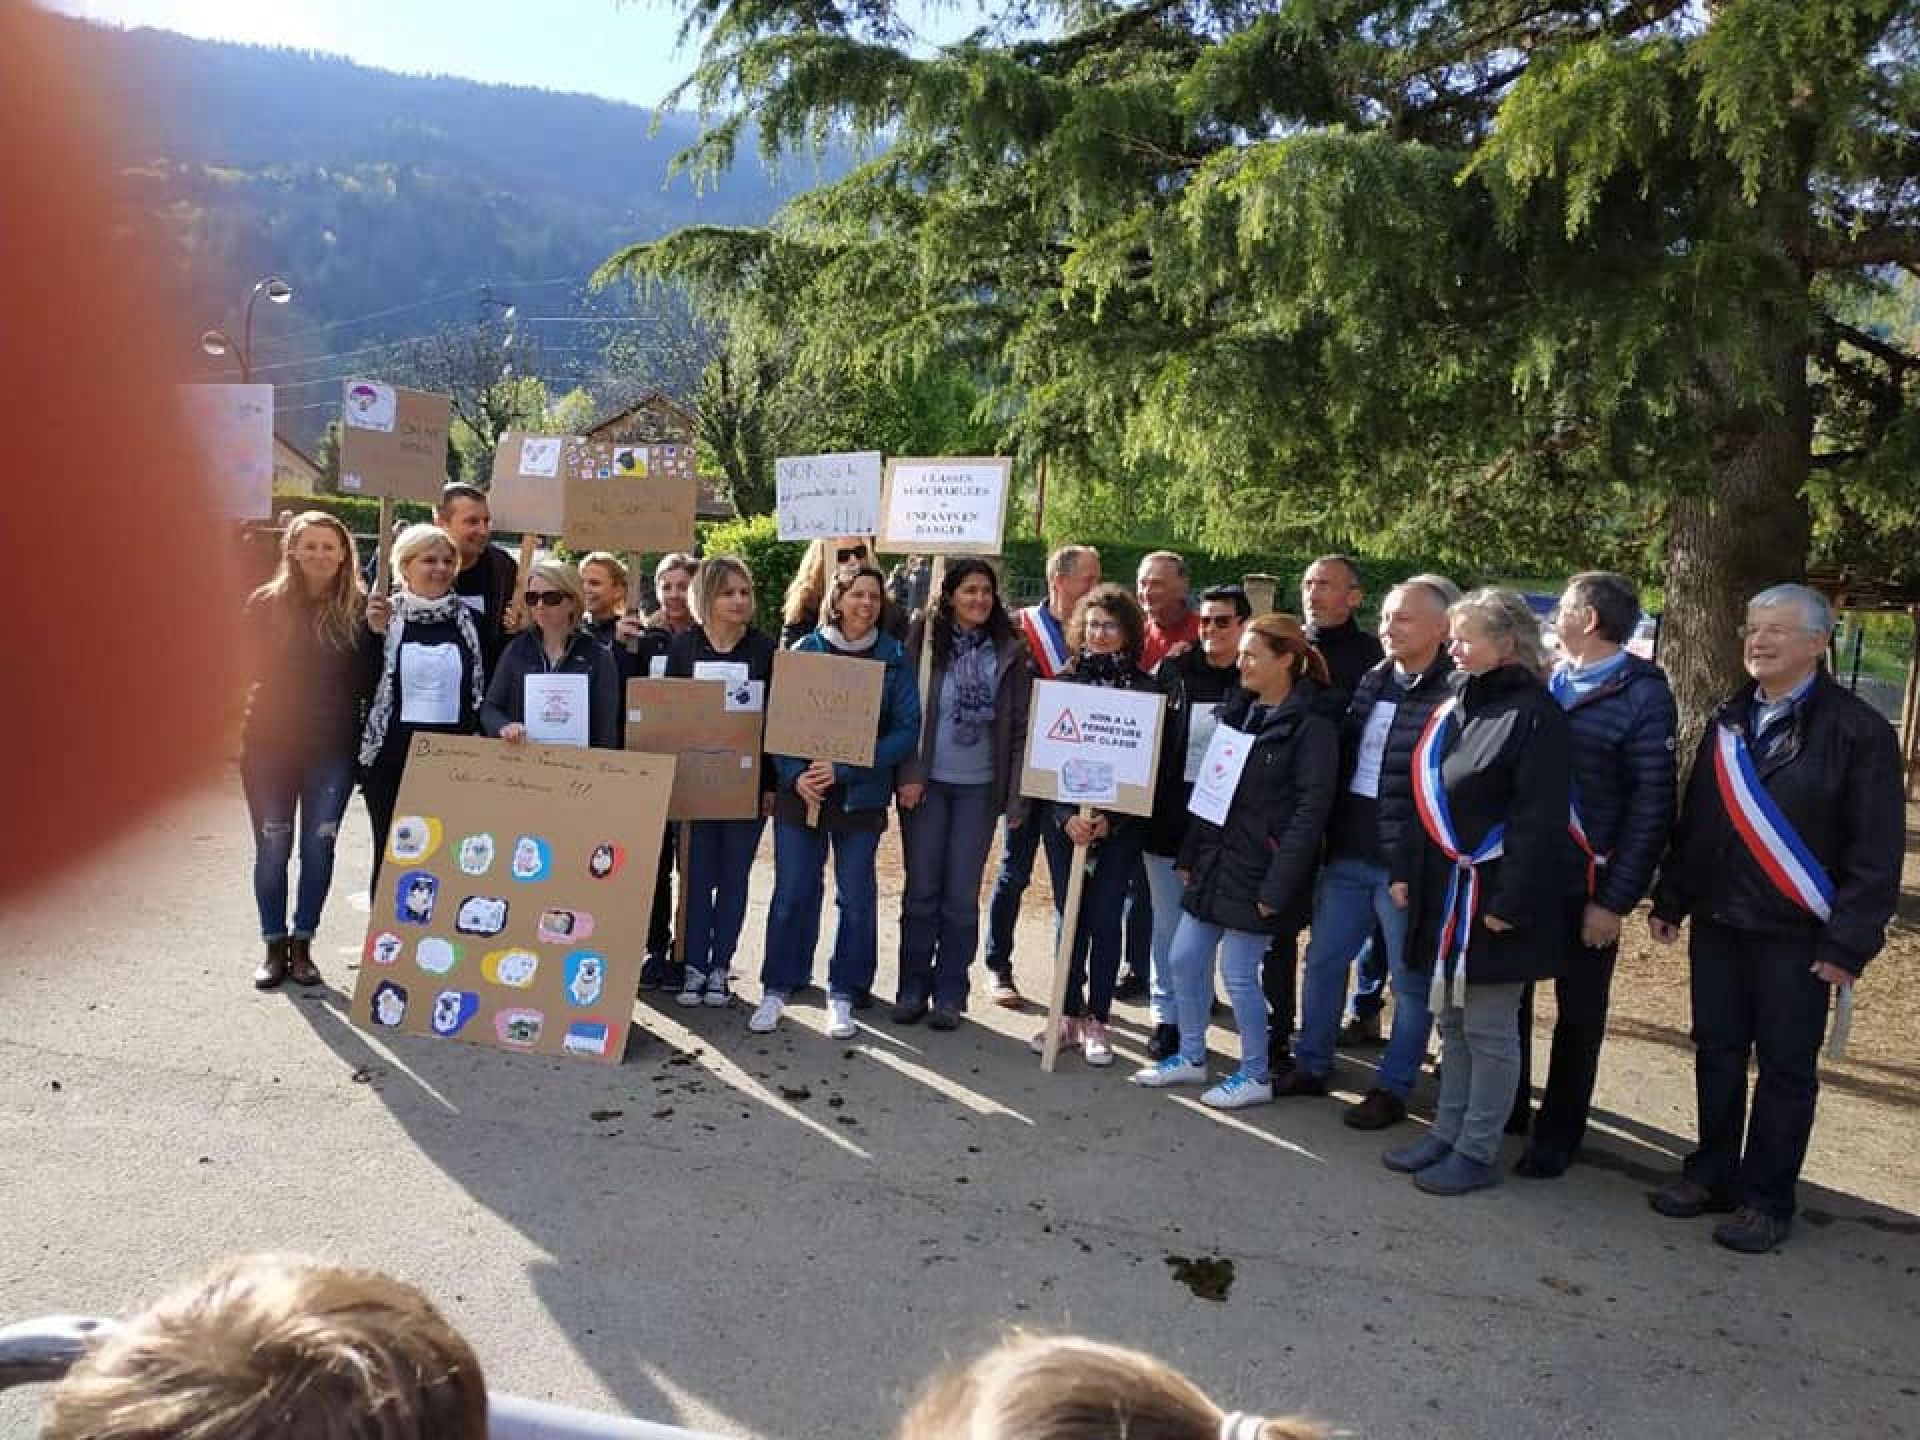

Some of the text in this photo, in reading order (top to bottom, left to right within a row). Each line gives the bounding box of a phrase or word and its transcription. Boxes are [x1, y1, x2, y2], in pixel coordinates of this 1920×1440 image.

[1089, 713, 1112, 723] NON
[1123, 715, 1137, 727] LA
[1081, 721, 1142, 738] FERMETURE
[1083, 734, 1138, 749] DE CLASSE
